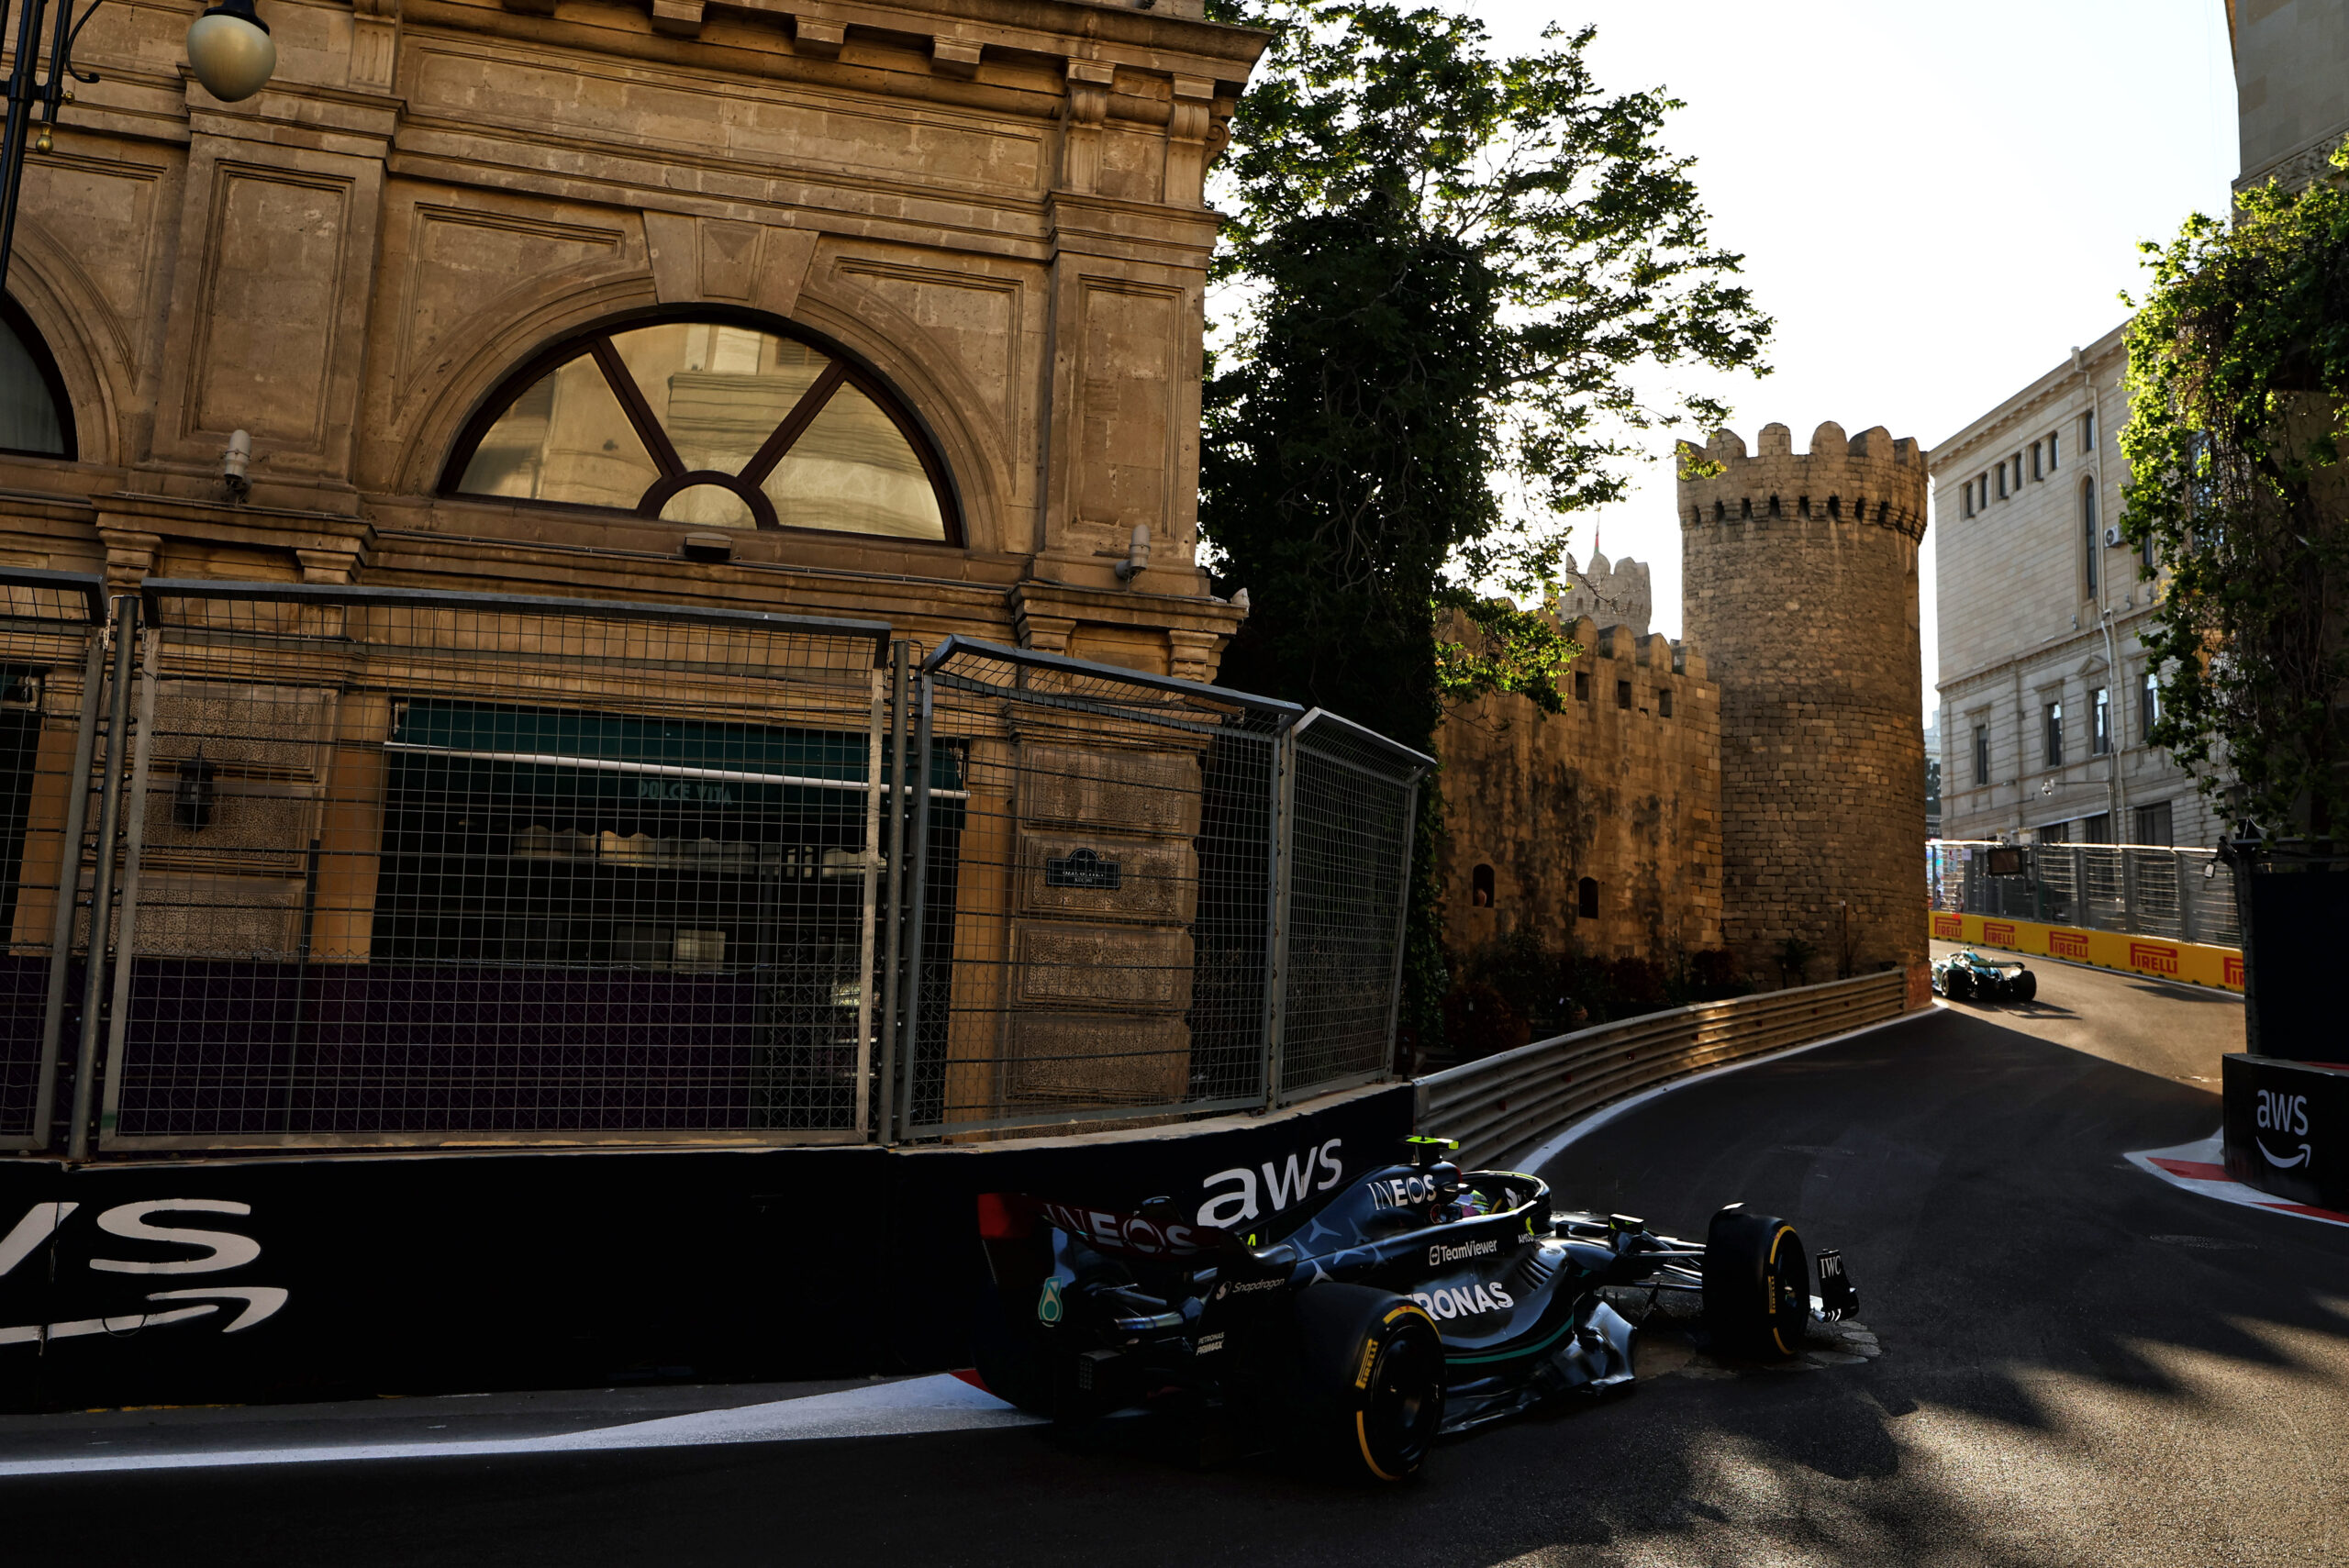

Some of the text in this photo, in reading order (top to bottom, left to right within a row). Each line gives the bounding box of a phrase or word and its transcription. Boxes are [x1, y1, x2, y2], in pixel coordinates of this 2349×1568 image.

[637, 780, 734, 806] DOLCE VITA
[1935, 917, 1962, 938] PIRELLI
[1984, 922, 2015, 946] PIRELLI
[2049, 930, 2088, 959] PIRELLI
[2131, 943, 2177, 974] PIRELLI
[2256, 1088, 2309, 1136] aws
[1197, 1138, 1342, 1229] aws
[1366, 1173, 1437, 1210] INEOS
[1042, 1203, 1198, 1256] INEOS
[1441, 1240, 1497, 1263] TeamViewer
[1820, 1255, 1842, 1279] IWC
[1232, 1278, 1286, 1294] Snapdragon
[1355, 1338, 1379, 1390] PIRELLI
